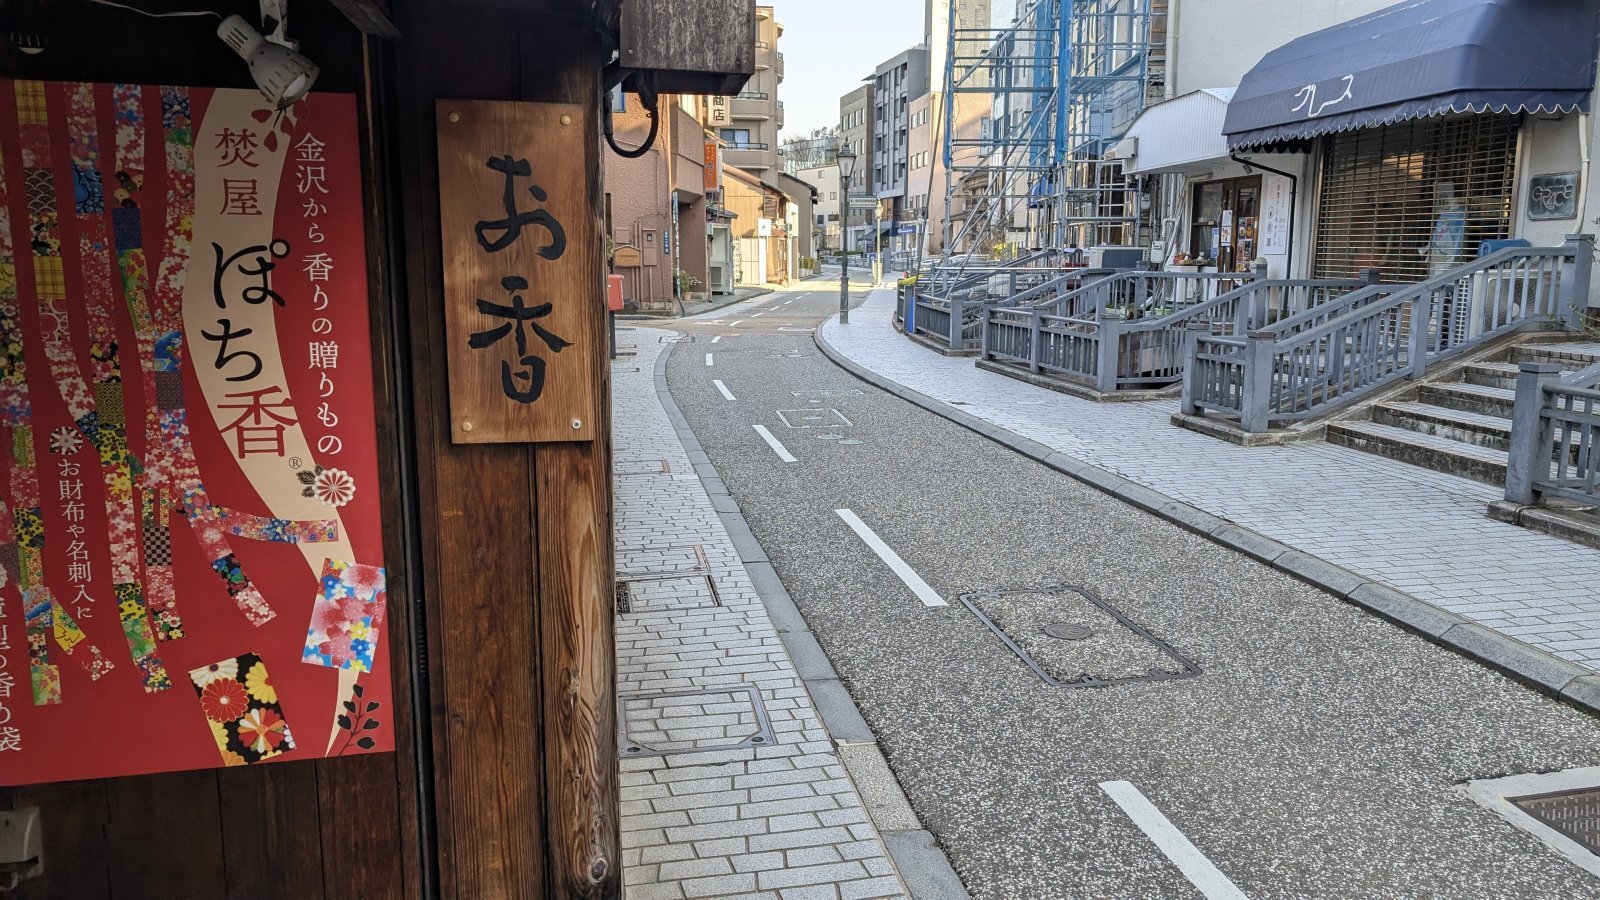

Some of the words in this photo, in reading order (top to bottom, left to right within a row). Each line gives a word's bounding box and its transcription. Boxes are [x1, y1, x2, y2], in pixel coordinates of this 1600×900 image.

[214, 127, 264, 216] 焚屋
[468, 154, 576, 404] お香
[201, 238, 300, 460] ぽち香
[293, 131, 344, 455] 金沢から香りの贈りもの
[57, 458, 96, 620] お財布や名刺入に
